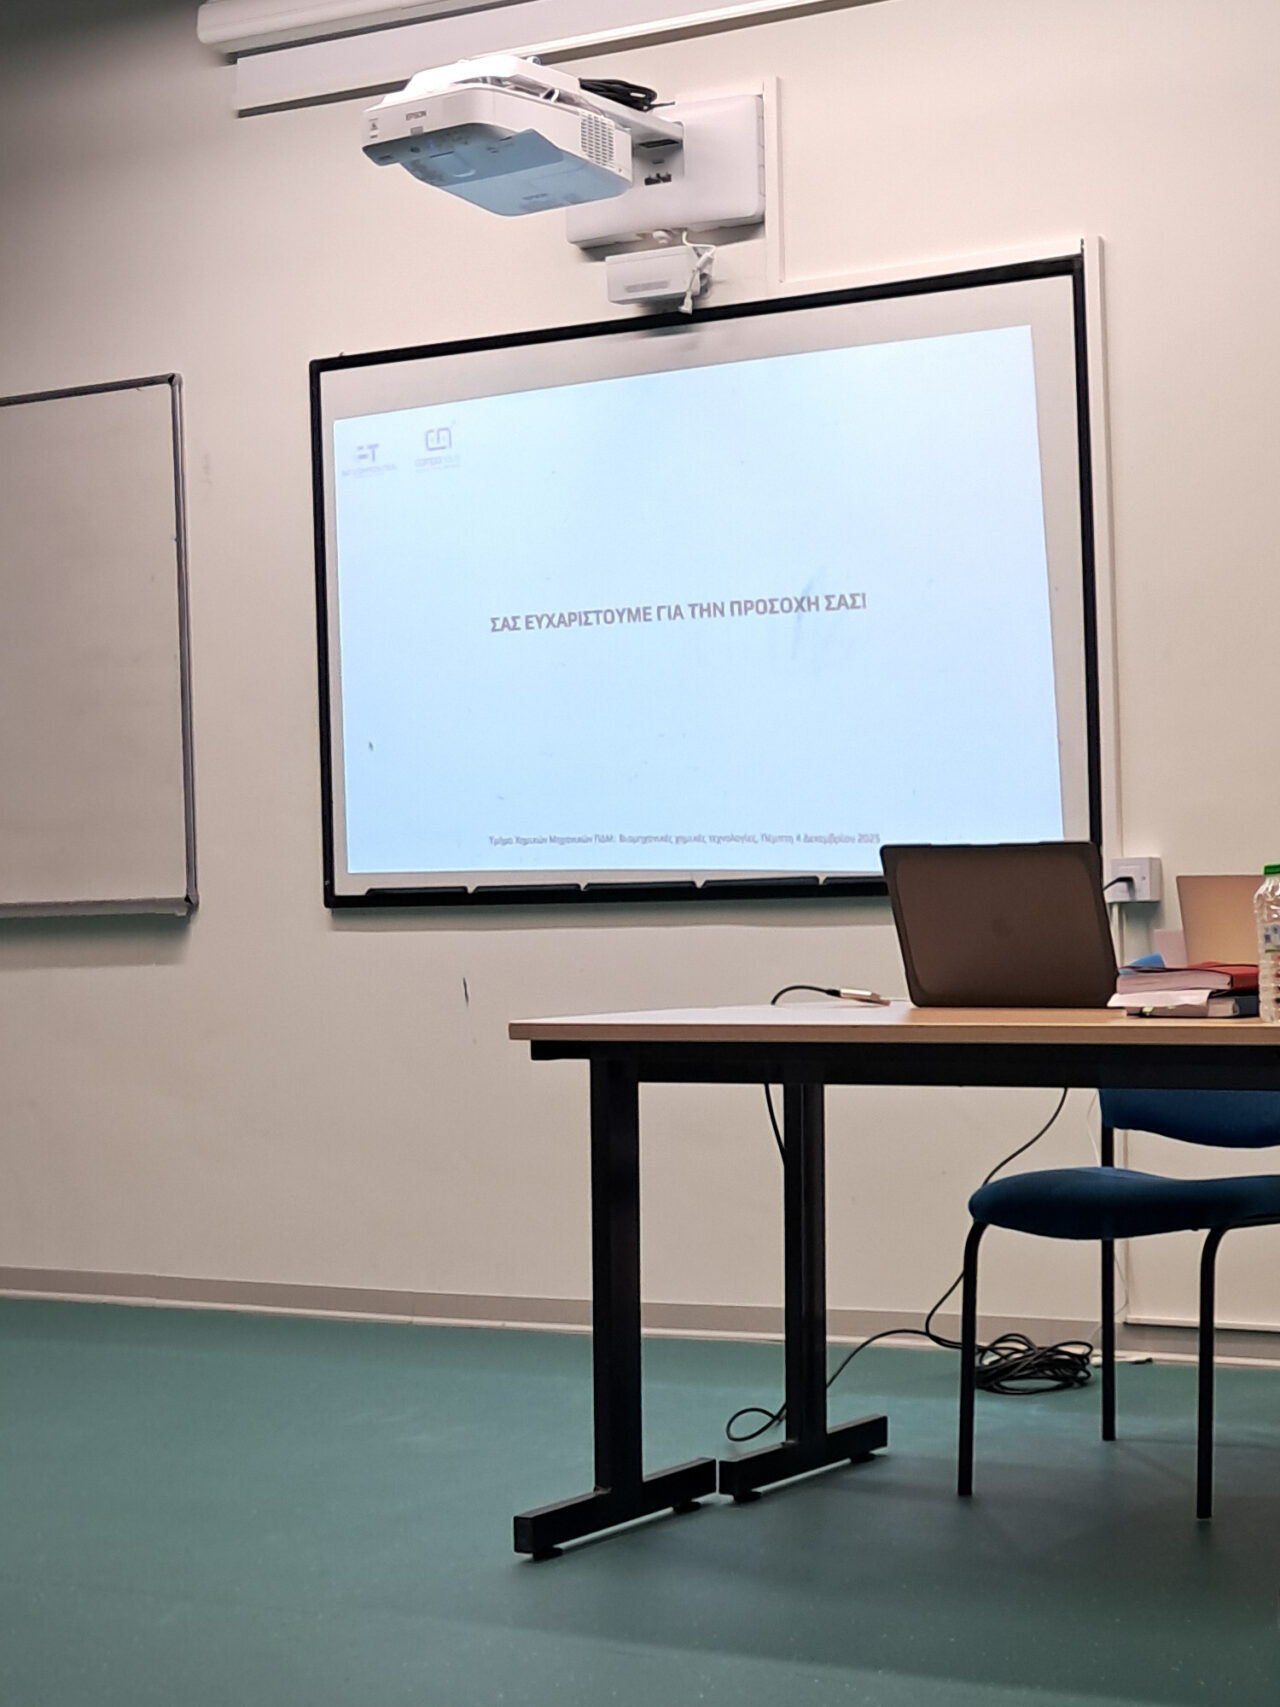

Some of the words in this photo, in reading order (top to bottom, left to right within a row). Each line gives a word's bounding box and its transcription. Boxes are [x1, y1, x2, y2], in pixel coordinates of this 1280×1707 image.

[490, 615, 522, 632] ΣΑΣ
[524, 606, 653, 630] ΕΥΧΑΡΙΣΤΟΥΜΕ
[656, 604, 685, 622] ΓΙΑ
[687, 601, 725, 619] ΤΗΝ
[729, 595, 820, 617] ΠΡΟΣΟΧΗ
